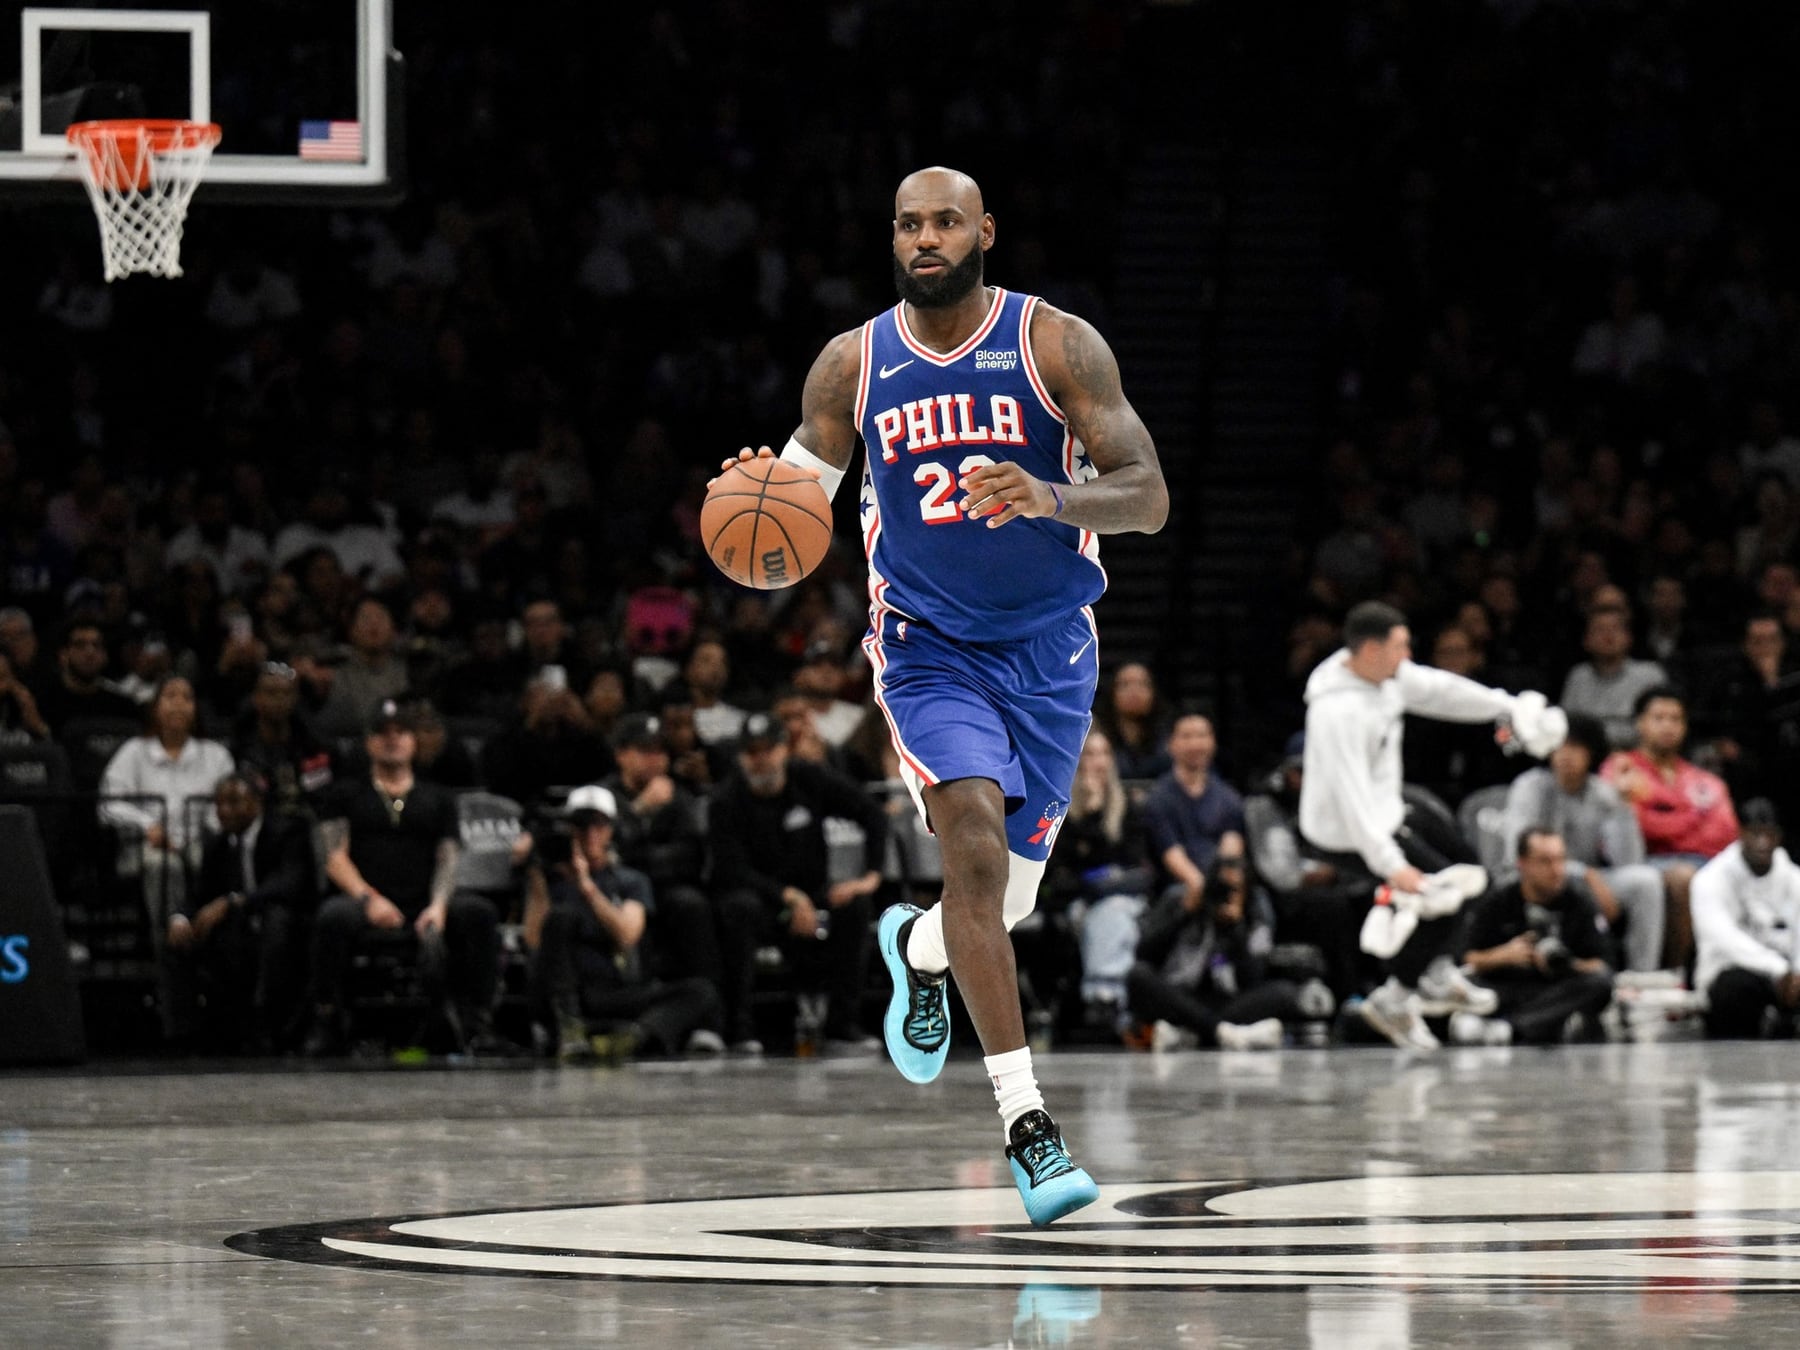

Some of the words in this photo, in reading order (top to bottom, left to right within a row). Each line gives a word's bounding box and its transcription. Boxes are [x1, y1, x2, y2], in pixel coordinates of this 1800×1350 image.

[975, 350, 1017, 360] Bloom
[975, 360, 1017, 370] energy
[874, 394, 1028, 464] PHILA
[0, 934, 29, 983] S
